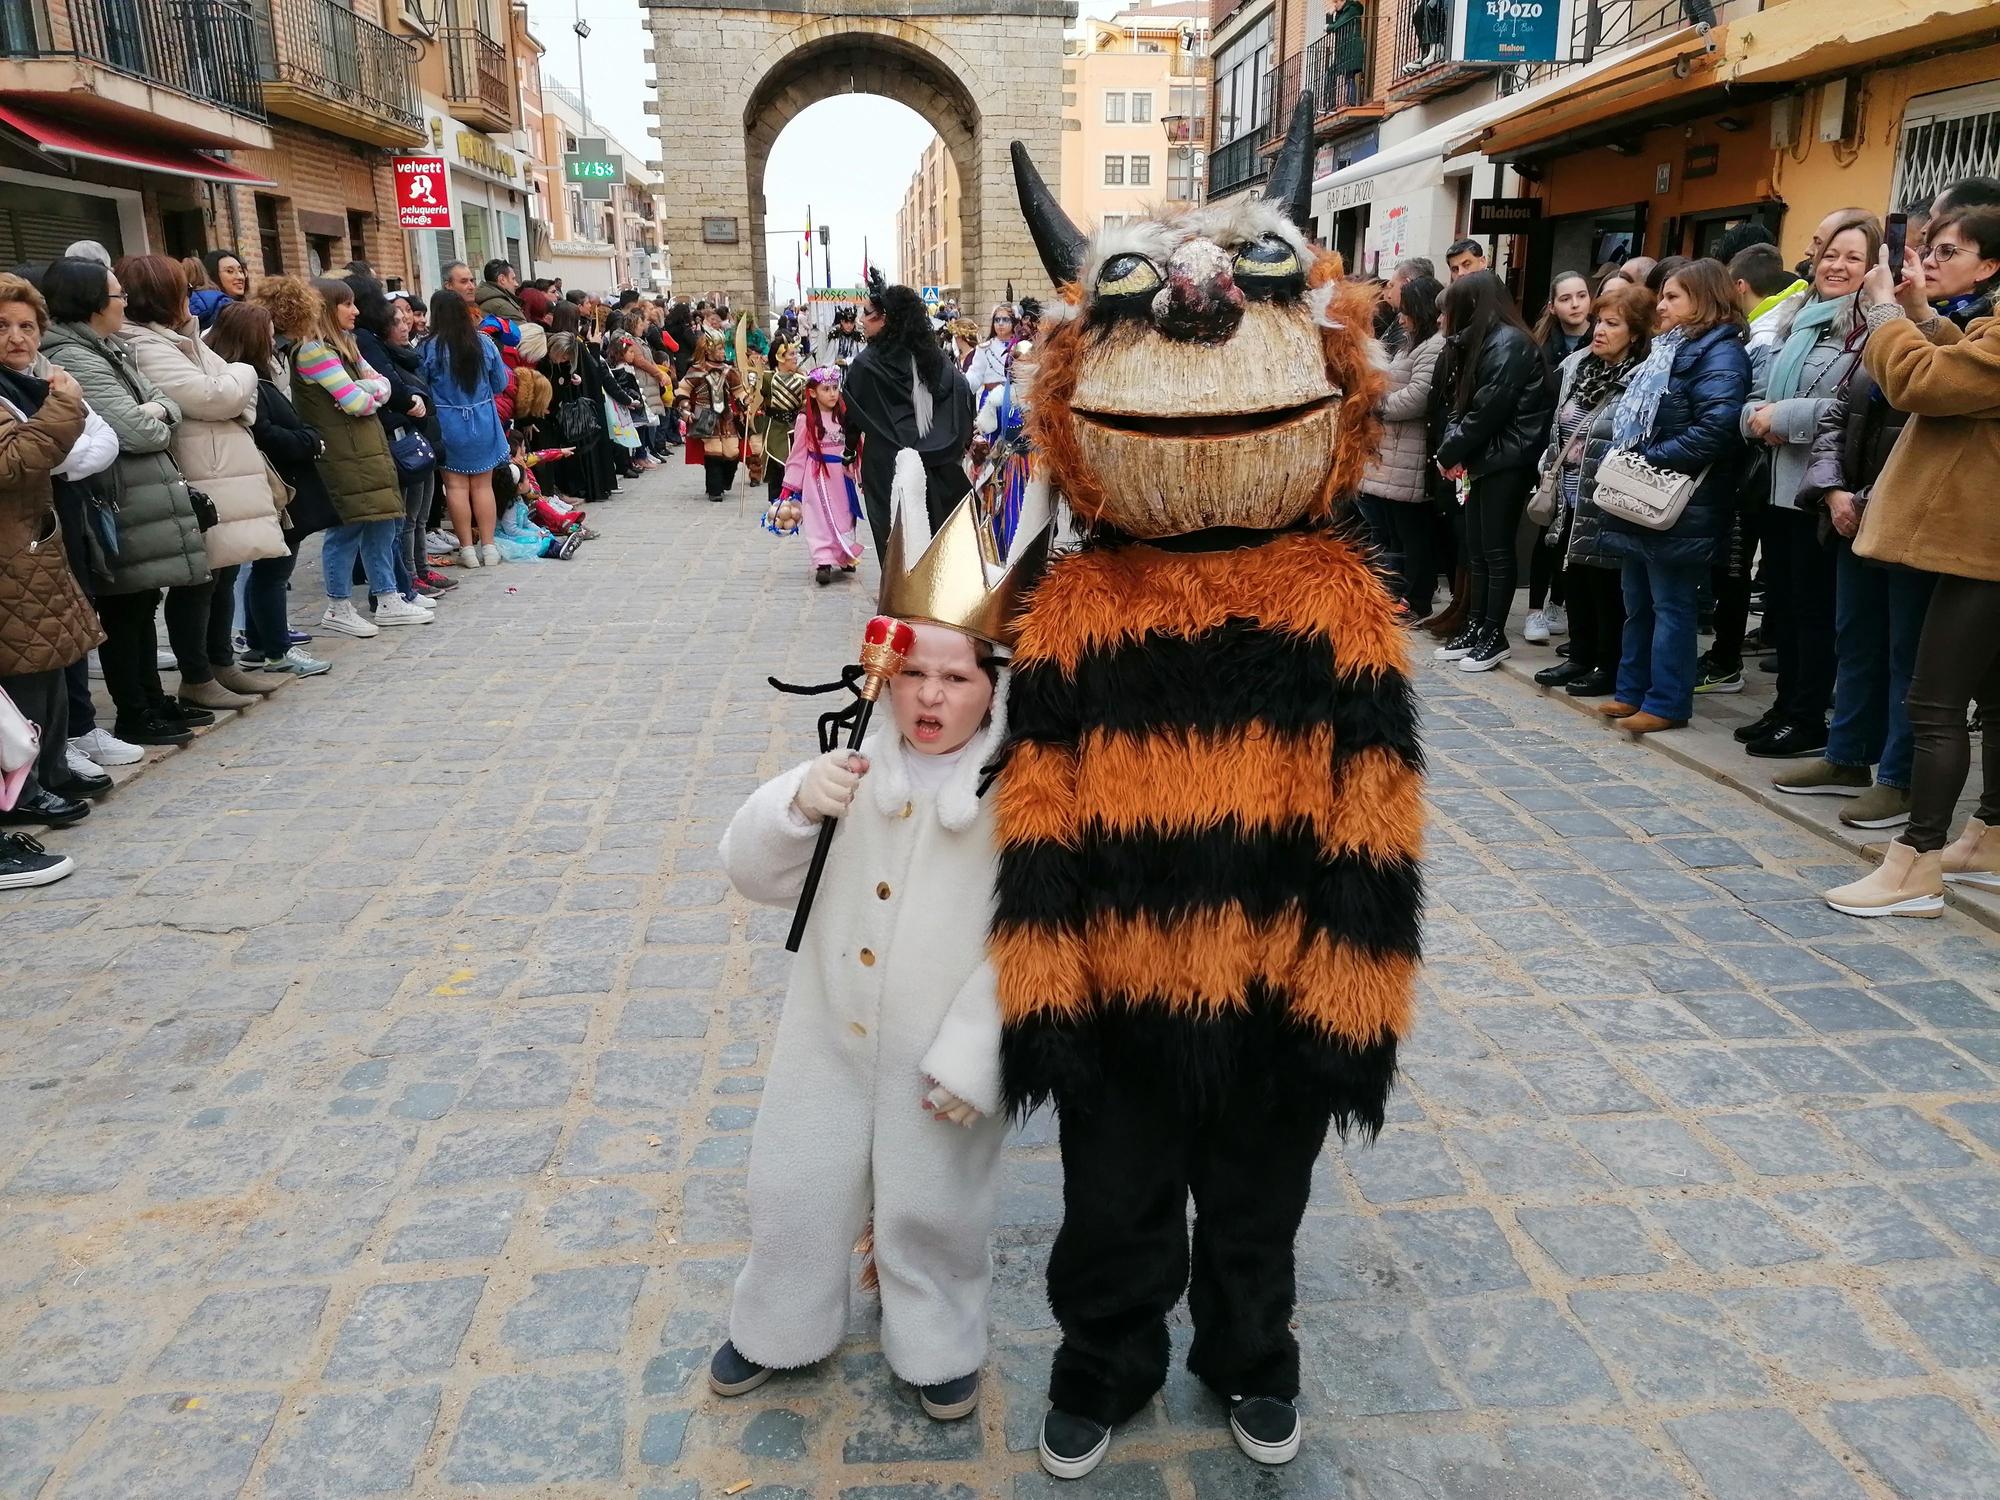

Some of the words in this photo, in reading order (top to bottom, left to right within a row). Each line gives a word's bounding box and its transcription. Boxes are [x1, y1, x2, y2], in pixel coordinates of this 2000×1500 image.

[1499, 43, 1525, 52] Mahou
[397, 160, 441, 173] velvett
[1327, 190, 1340, 210] BAR
[1342, 186, 1351, 206] EL
[1354, 180, 1375, 203] POZO
[1481, 205, 1531, 219] Mahou
[401, 215, 432, 225] chic@s
[814, 290, 848, 301] DIOSES
